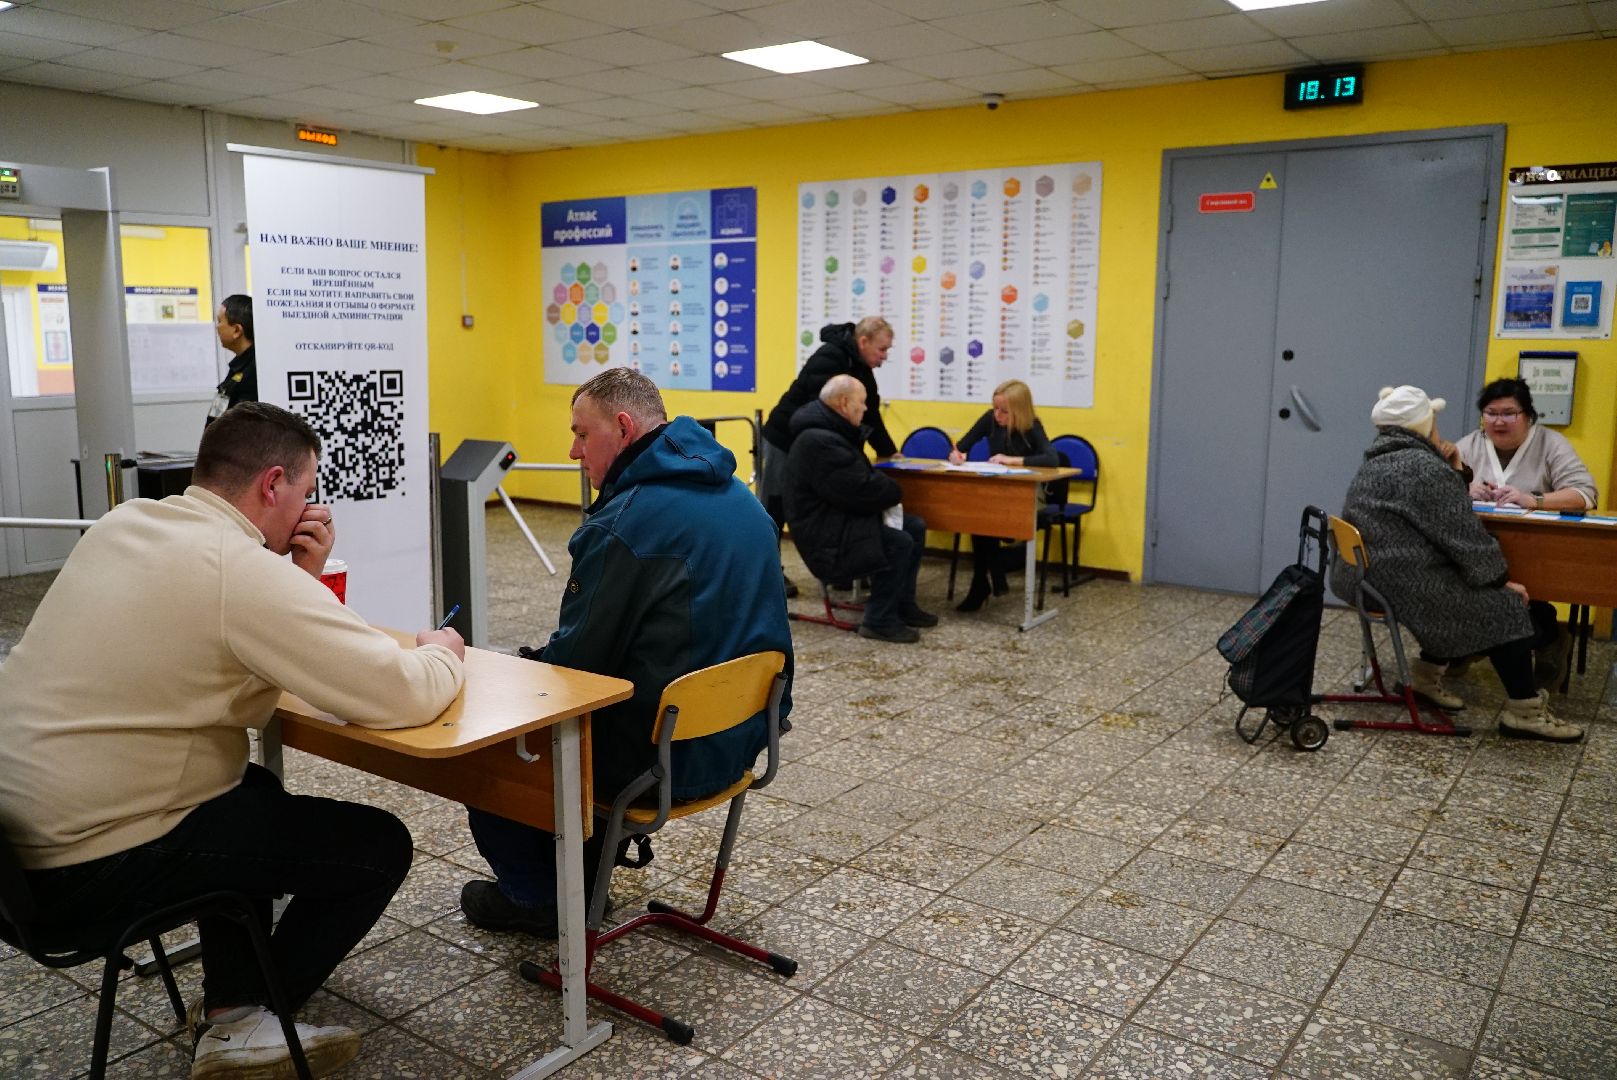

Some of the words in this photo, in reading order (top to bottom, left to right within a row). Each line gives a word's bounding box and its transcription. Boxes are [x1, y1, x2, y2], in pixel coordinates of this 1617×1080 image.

[299, 130, 337, 145] ВЫХОД
[567, 209, 598, 223] Атлас
[553, 223, 613, 243] профессий
[260, 233, 287, 244] НАМ
[291, 236, 333, 247] ВАЖНО
[336, 239, 367, 250] ВАШЕ
[370, 240, 419, 253] МНЕНИЕ!
[281, 266, 304, 275] ЕСЛИ
[307, 268, 327, 276] ВАШ
[328, 269, 362, 278] ВОПРОС
[363, 271, 401, 280] ОСТАЛСЯ
[312, 278, 375, 288] НЕРЕШЁННЫМ
[267, 288, 291, 297] ЕСЛИ
[293, 289, 308, 298] ВЫ
[309, 290, 343, 299] ХОТИТЕ
[345, 291, 392, 300] НАПРАВИТЬ
[393, 292, 415, 301] СВОИ
[266, 299, 324, 309] ПОЖЕЛАНИЯ
[325, 301, 332, 309] И
[333, 301, 369, 310] ОТЗЫВЫ
[370, 302, 377, 310] О
[378, 302, 416, 312] ФОРМАТЕ
[282, 310, 330, 320] ВЫЕЗДНОЙ
[331, 311, 404, 321] АДМИНИСТРАЦИИ
[295, 342, 364, 351] ОТСКАНИРУЙТЕ
[364, 342, 395, 352] QR-КОД
